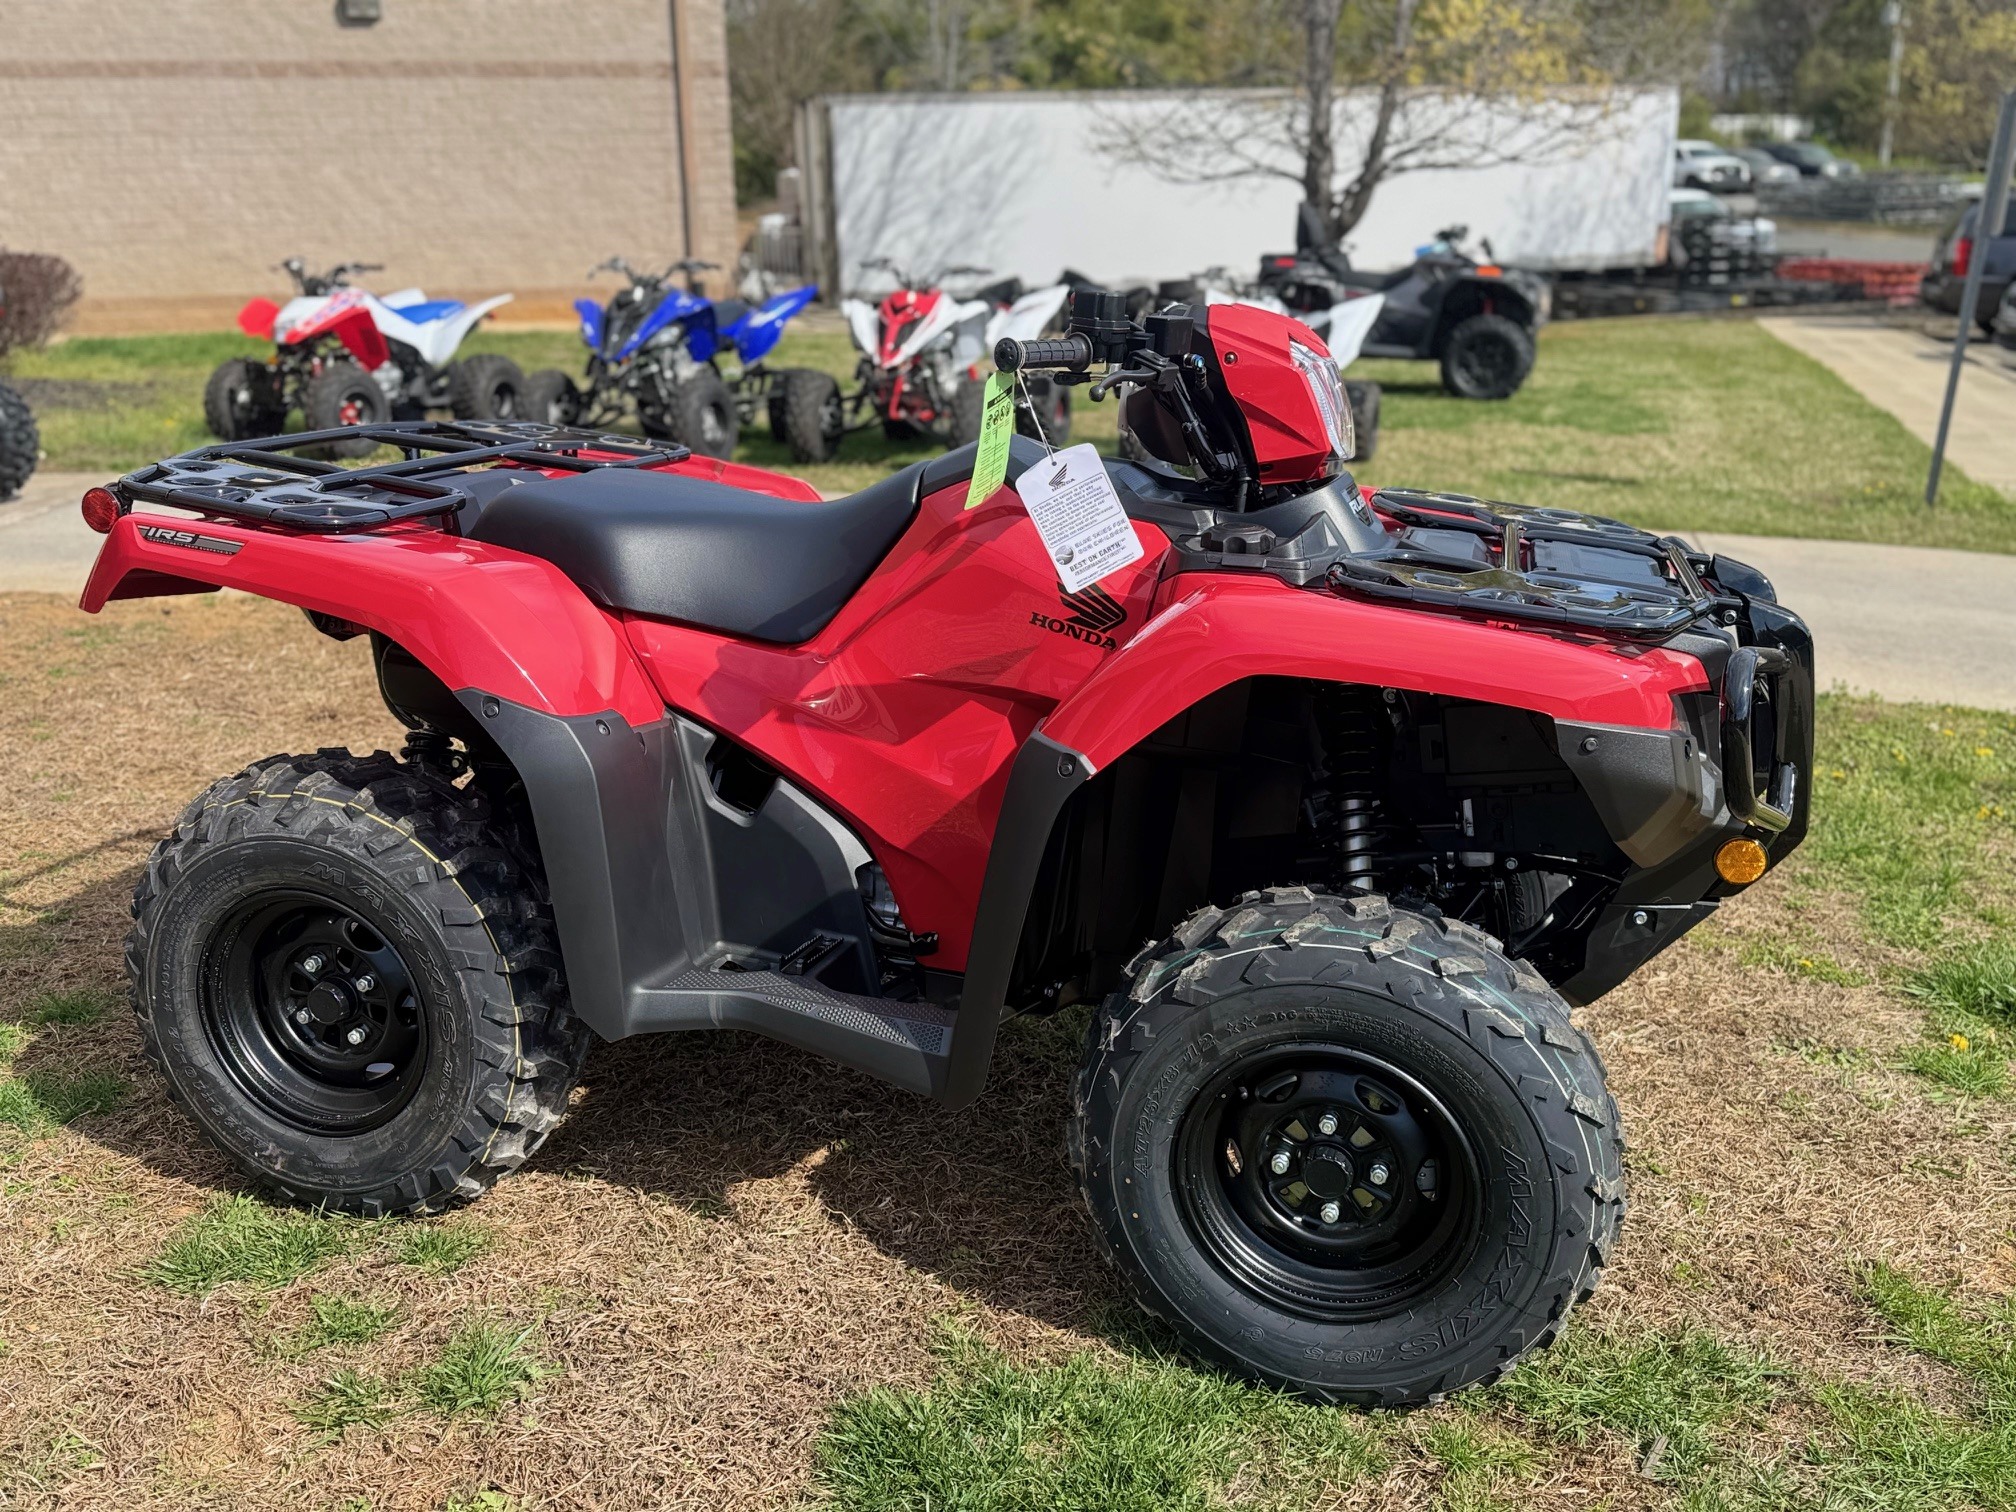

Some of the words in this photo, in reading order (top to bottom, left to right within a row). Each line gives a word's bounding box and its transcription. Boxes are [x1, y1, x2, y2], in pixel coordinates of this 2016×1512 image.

[148, 527, 195, 542] IRS
[1069, 558, 1087, 572] BEST
[1087, 553, 1097, 562] ON
[1030, 612, 1117, 651] HONDA
[305, 861, 458, 1046] MAXXIS
[1399, 1144, 1534, 1362] MAXXIS
[1302, 1347, 1384, 1364] M975
